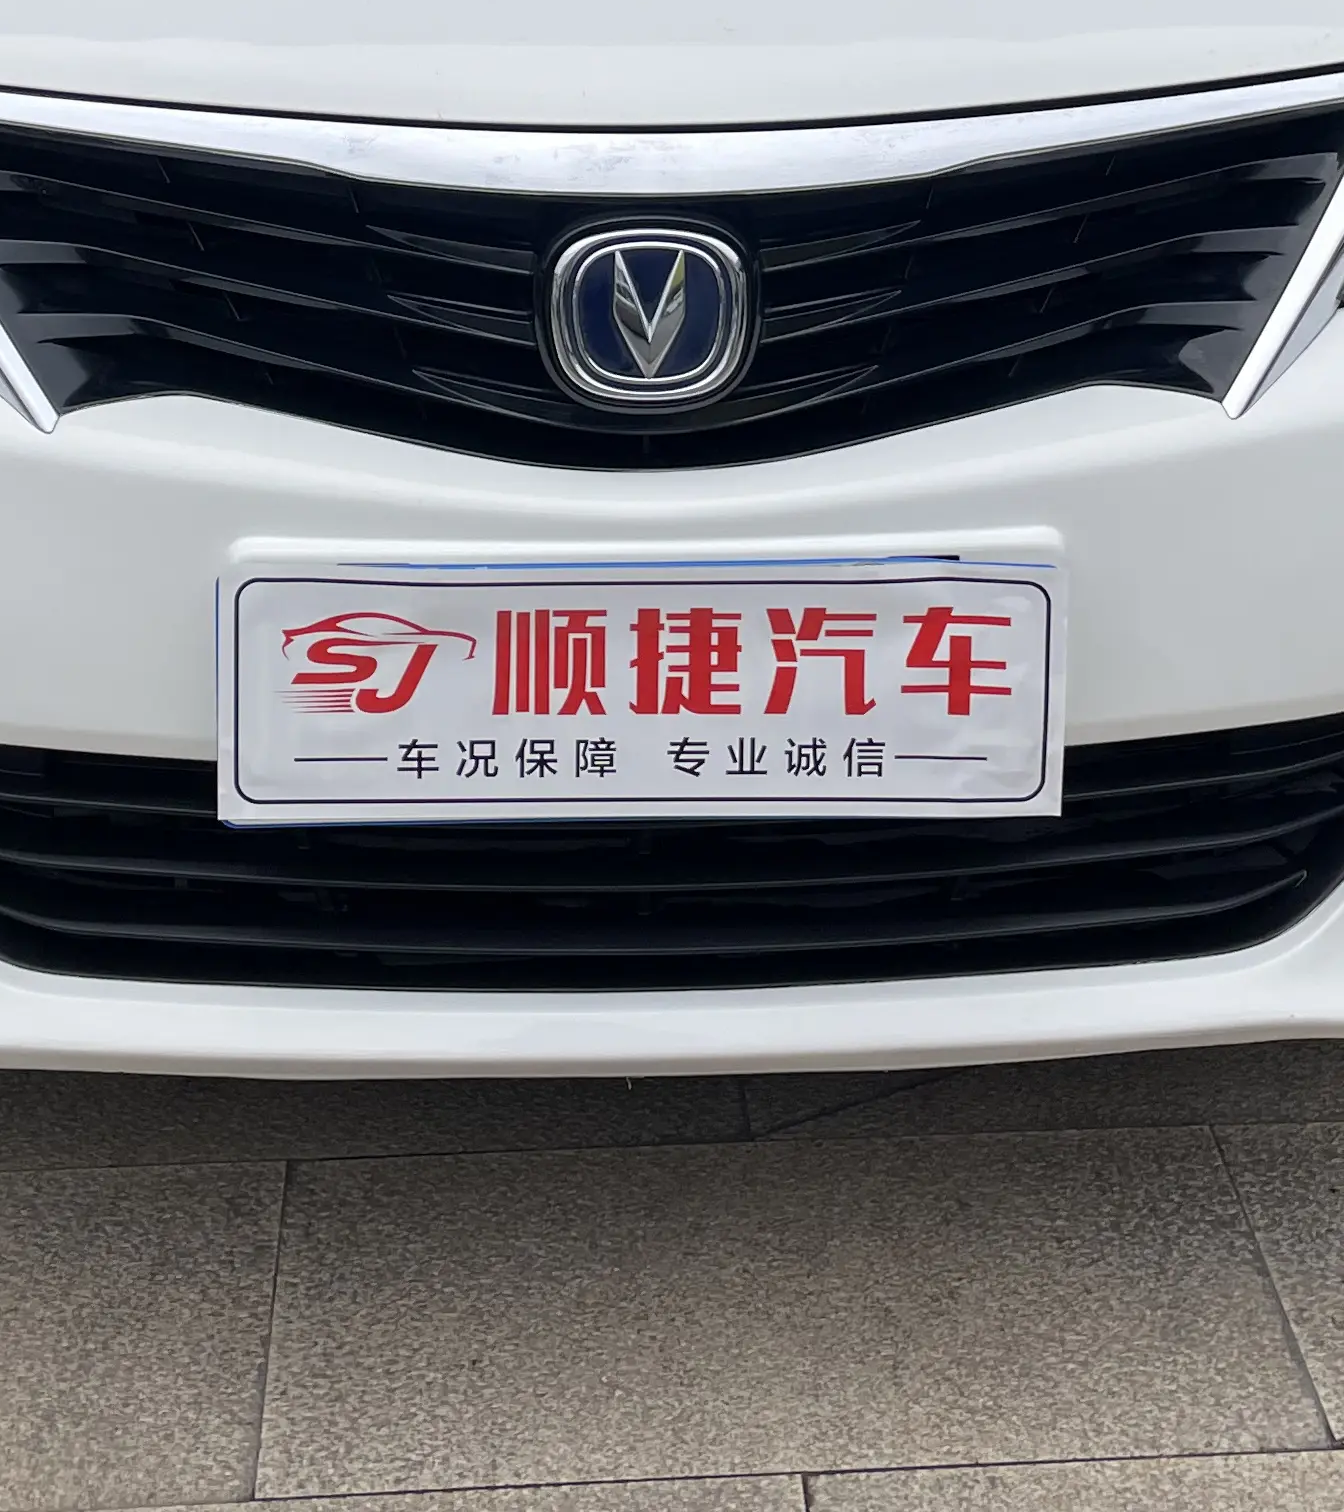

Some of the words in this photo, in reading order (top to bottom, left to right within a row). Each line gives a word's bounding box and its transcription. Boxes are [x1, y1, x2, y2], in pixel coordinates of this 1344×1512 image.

[490, 605, 1013, 718] 顺捷汽车
[397, 738, 619, 780] 车况保障
[666, 737, 886, 780] 专业诚信
